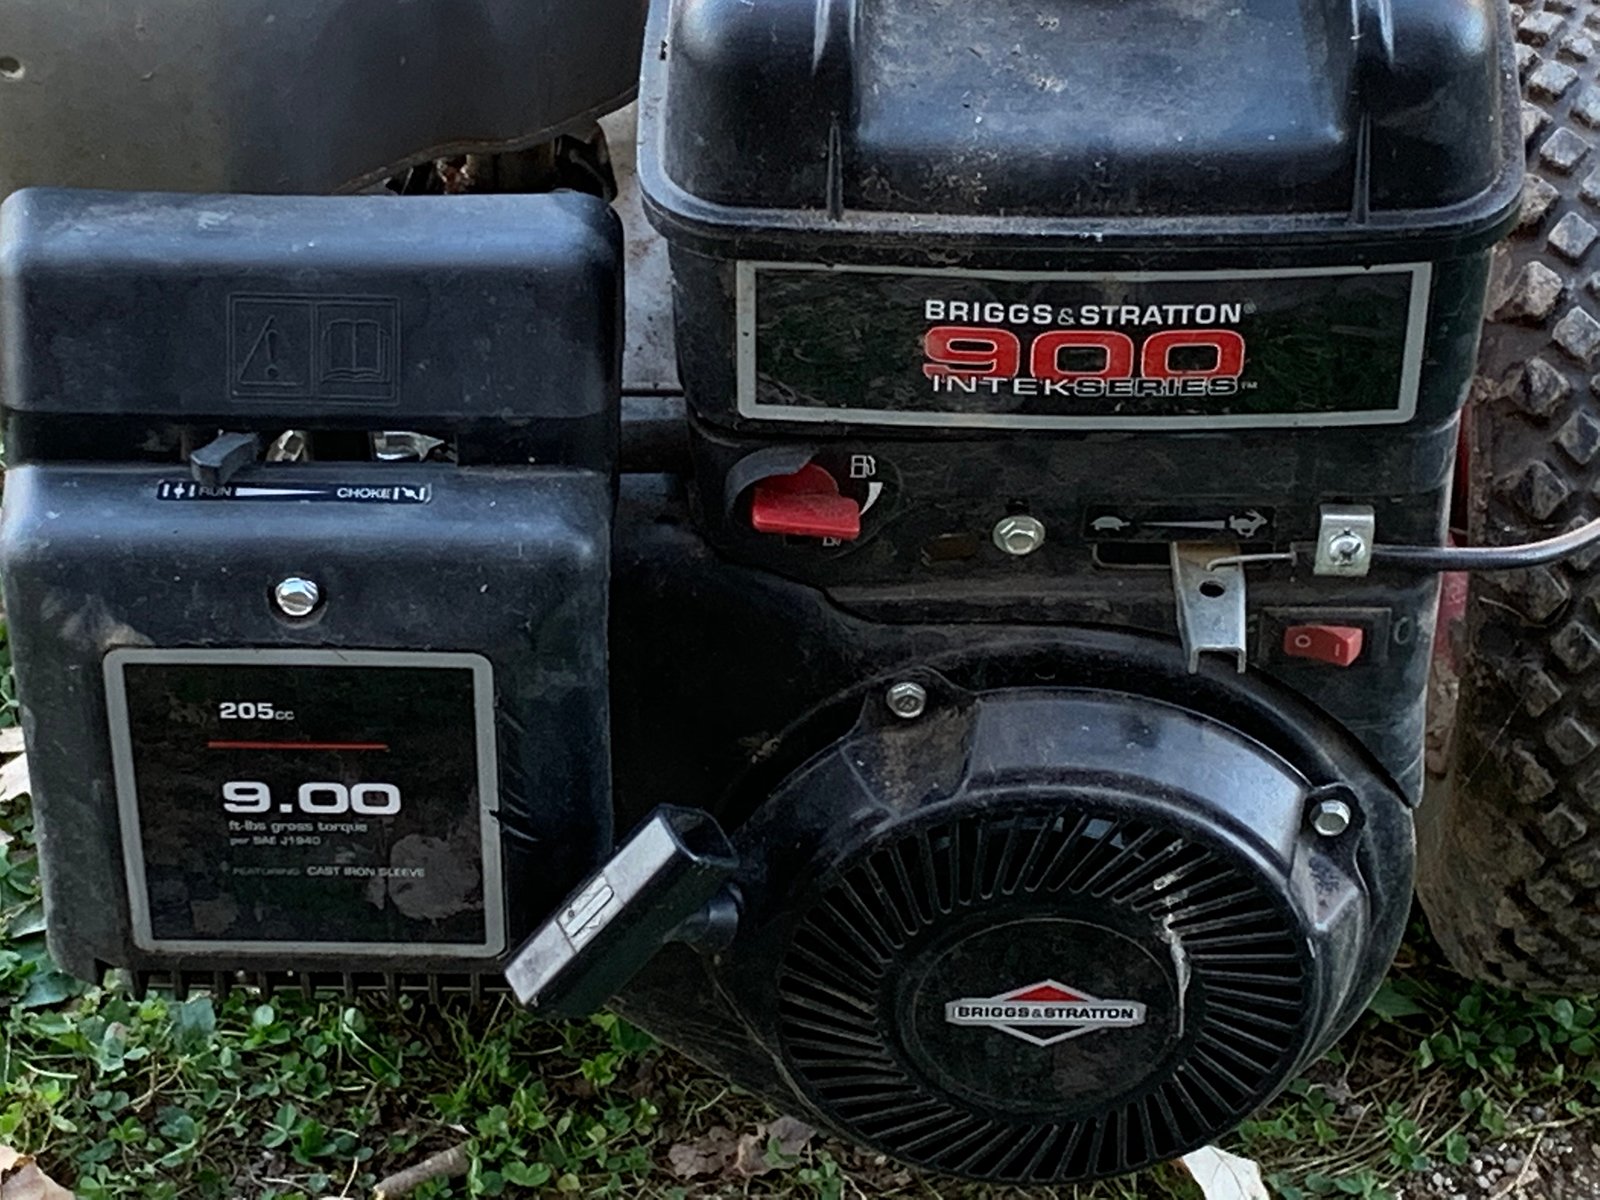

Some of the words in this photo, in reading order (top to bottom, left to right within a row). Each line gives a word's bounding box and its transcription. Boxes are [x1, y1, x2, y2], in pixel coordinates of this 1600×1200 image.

[923, 326, 1245, 379] 900
[199, 486, 232, 497] RUN
[337, 488, 391, 499] CHOKE
[222, 781, 401, 815] 9.00
[271, 822, 313, 834] gross
[317, 822, 368, 834] torque
[306, 866, 339, 876] CAST
[343, 866, 375, 876] IRON
[378, 866, 425, 878] SLEEVE
